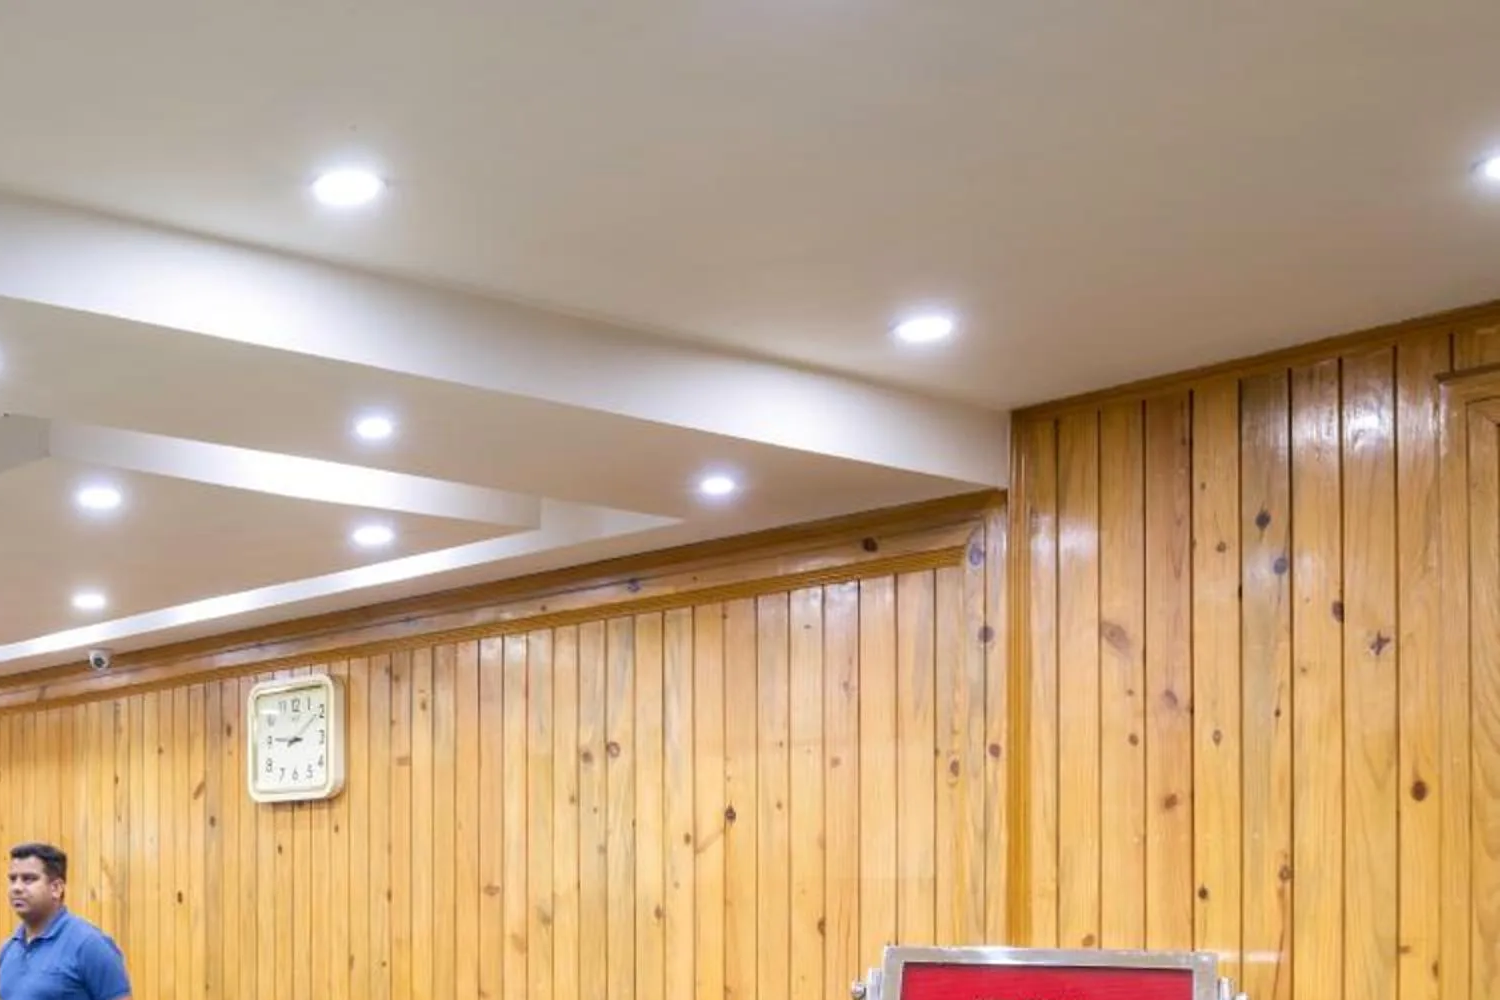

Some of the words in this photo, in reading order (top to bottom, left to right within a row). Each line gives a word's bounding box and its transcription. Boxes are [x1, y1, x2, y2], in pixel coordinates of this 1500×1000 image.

[291, 697, 301, 713] 12
[318, 703, 325, 719] 2
[265, 757, 273, 773] 8
[306, 763, 314, 779] 5
[279, 766, 286, 783] 7
[291, 766, 299, 781] 6
